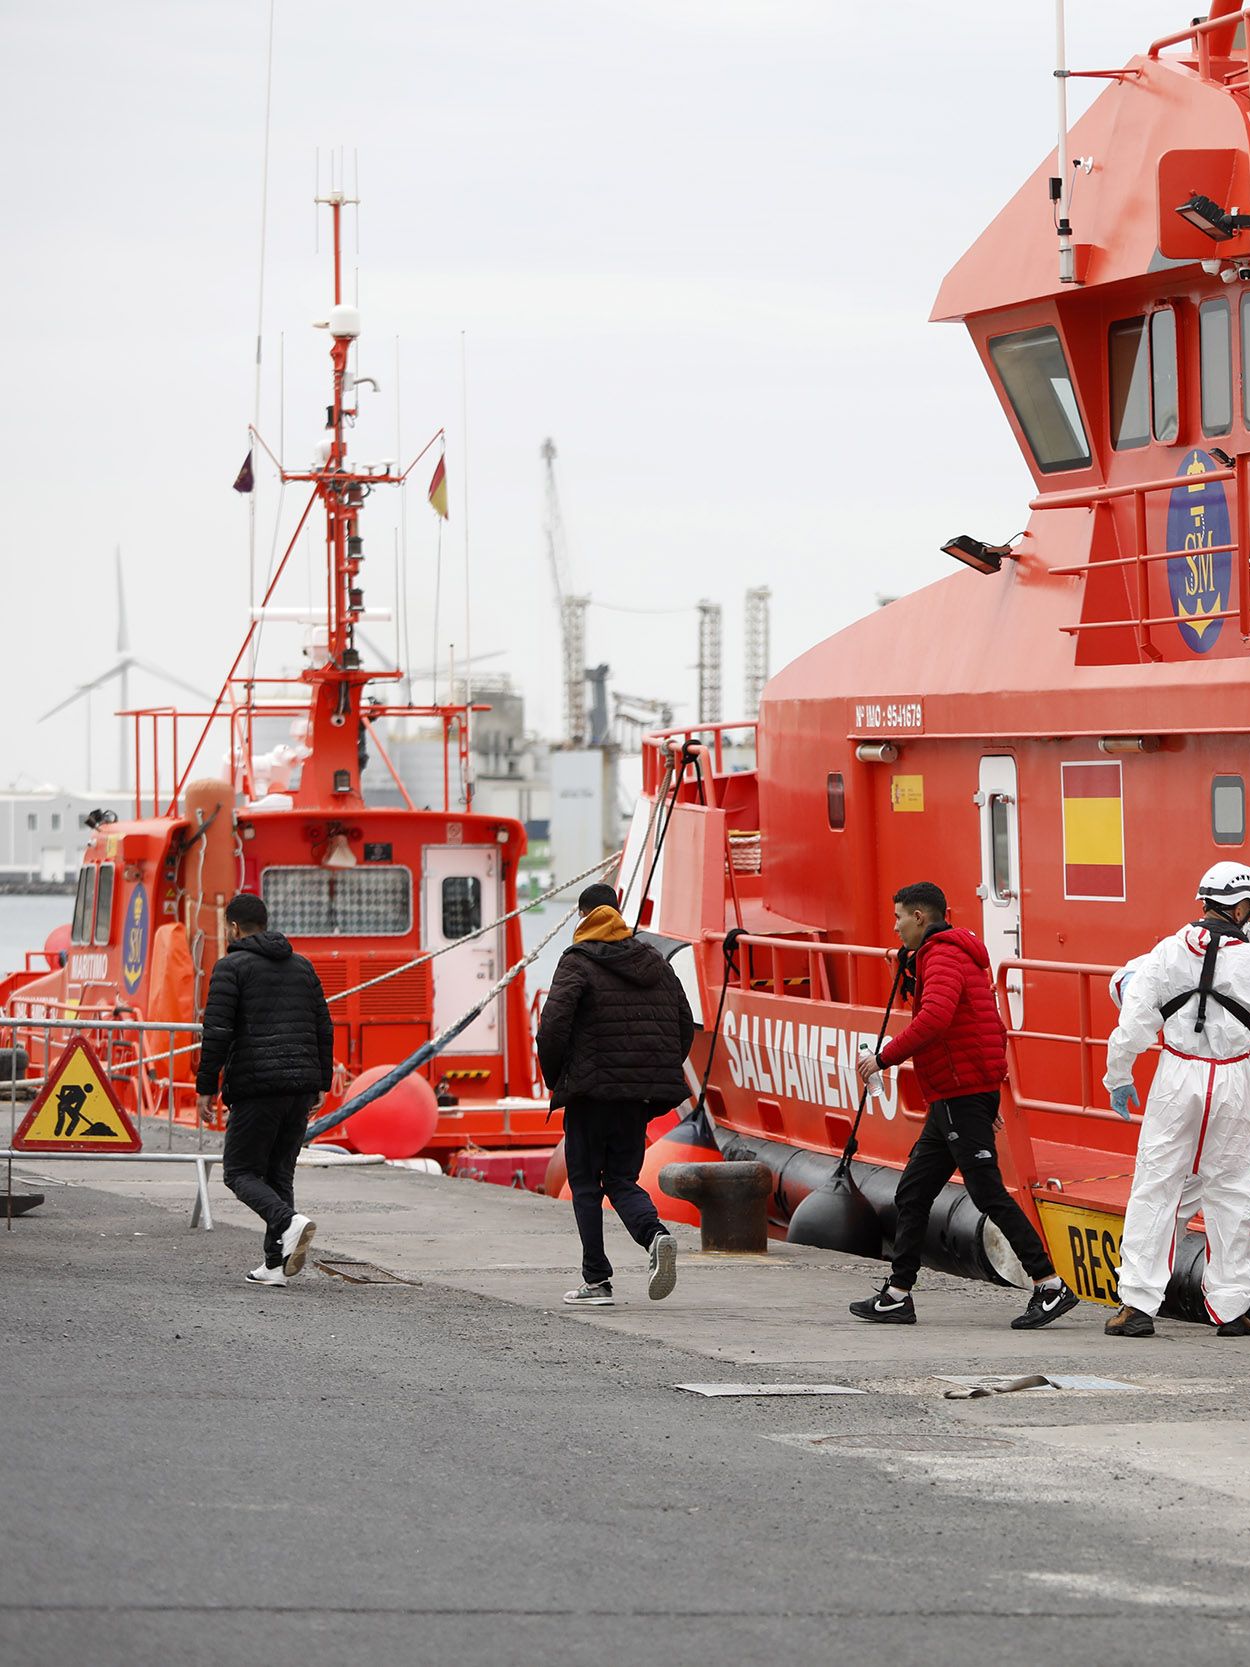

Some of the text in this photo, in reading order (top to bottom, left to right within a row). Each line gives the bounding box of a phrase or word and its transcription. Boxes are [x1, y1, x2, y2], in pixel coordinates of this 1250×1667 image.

[1184, 530, 1216, 597] SM
[887, 703, 922, 728] 9541679
[722, 1009, 899, 1121] SALVAMENTO
[1067, 1224, 1124, 1304] RES
